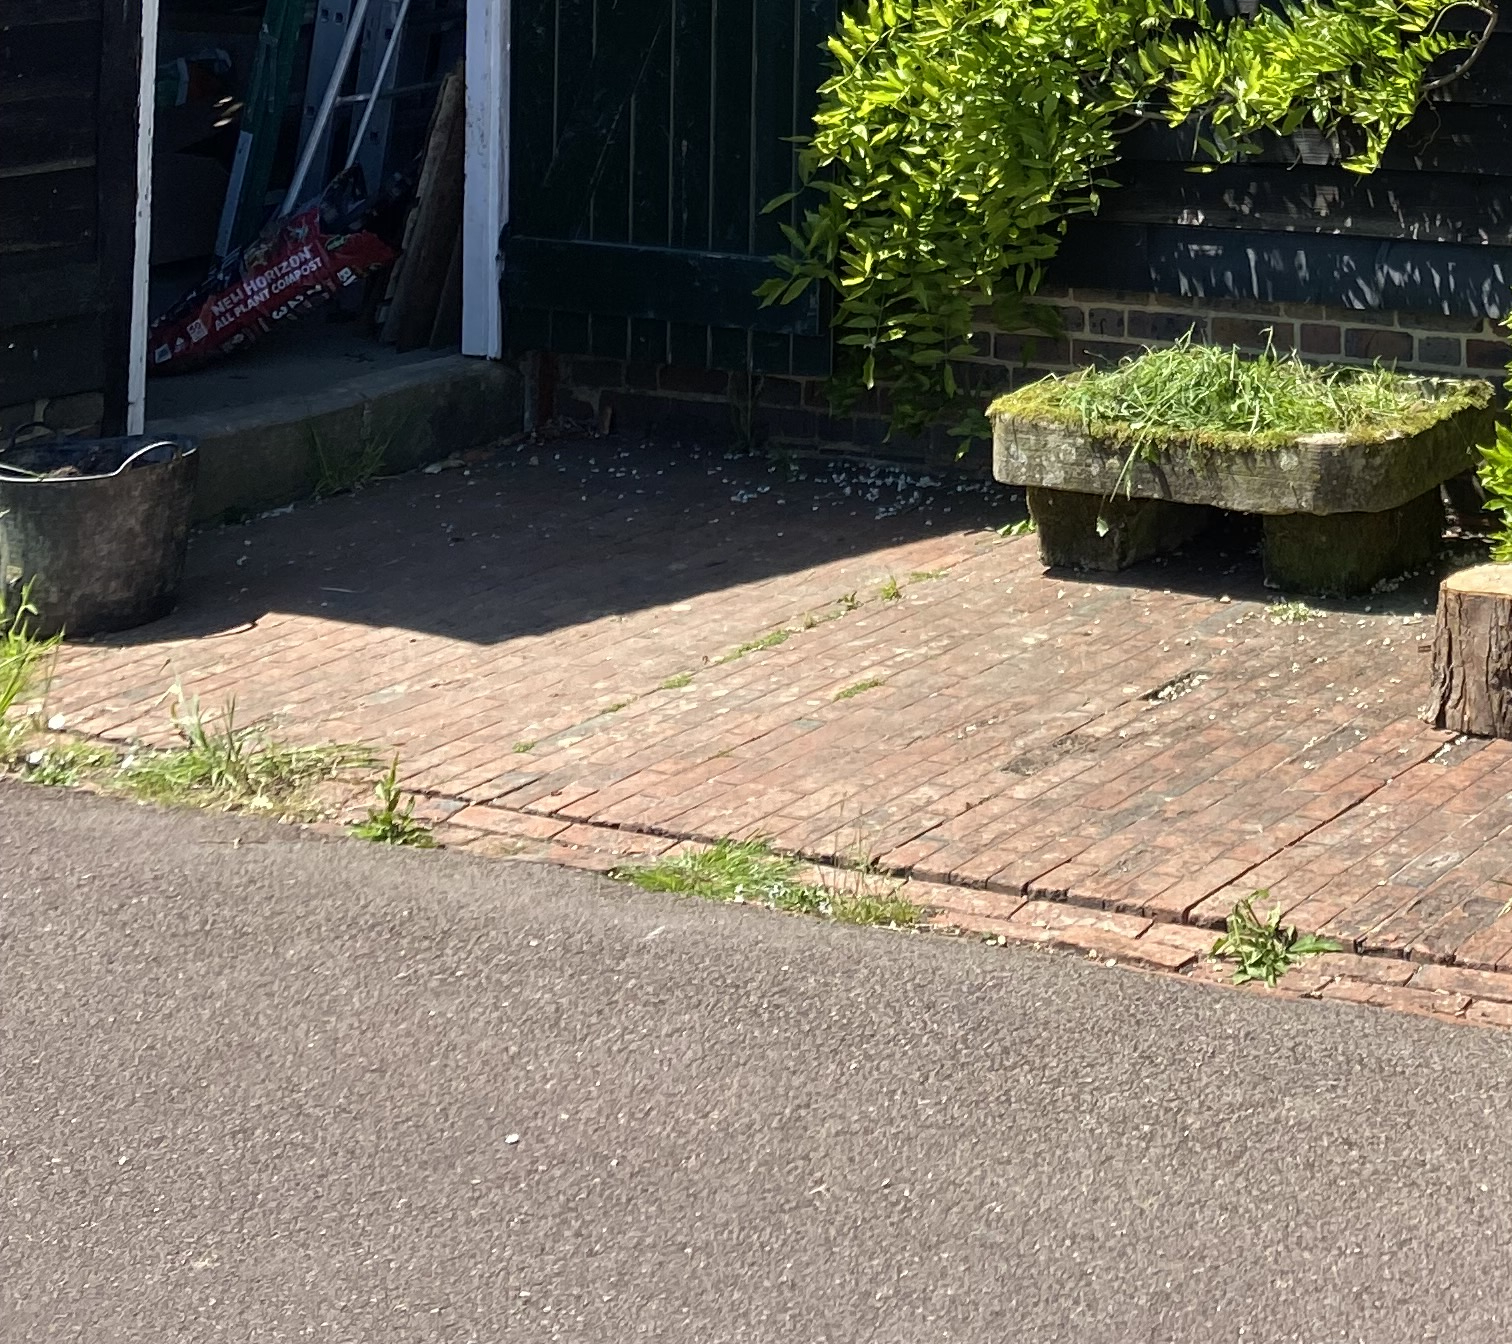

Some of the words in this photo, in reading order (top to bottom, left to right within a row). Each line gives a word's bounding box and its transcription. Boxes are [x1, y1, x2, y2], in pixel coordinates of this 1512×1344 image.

[211, 287, 244, 316] NEW
[243, 243, 312, 295] HORIZON
[214, 312, 234, 331] ALL
[233, 289, 270, 318] PLANT
[271, 256, 323, 294] COMPOST
